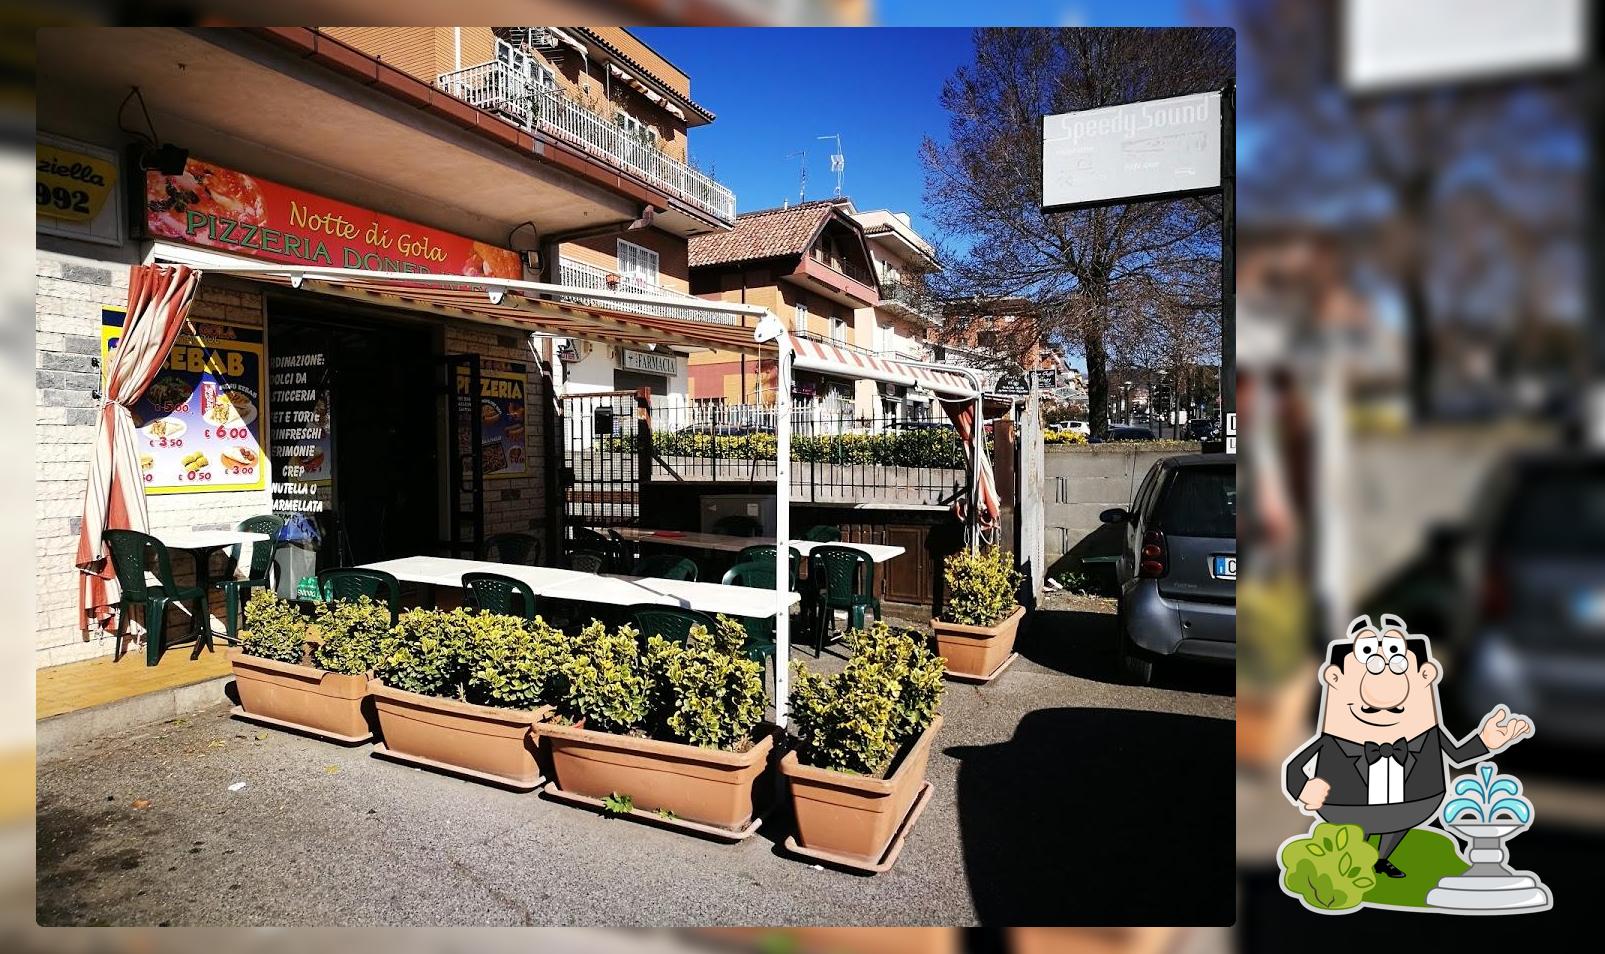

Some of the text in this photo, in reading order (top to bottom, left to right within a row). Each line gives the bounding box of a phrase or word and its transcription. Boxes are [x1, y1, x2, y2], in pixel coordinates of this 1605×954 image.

[1054, 96, 1209, 145] Speedy Sound
[186, 210, 332, 265] PIZZERIA
[290, 201, 448, 262] Notte di Gola
[164, 345, 245, 377] EBAB
[638, 353, 675, 373] FARMACIA
[296, 372, 307, 384] DA
[282, 465, 305, 477] CREP
[272, 482, 308, 494] NUTELLA
